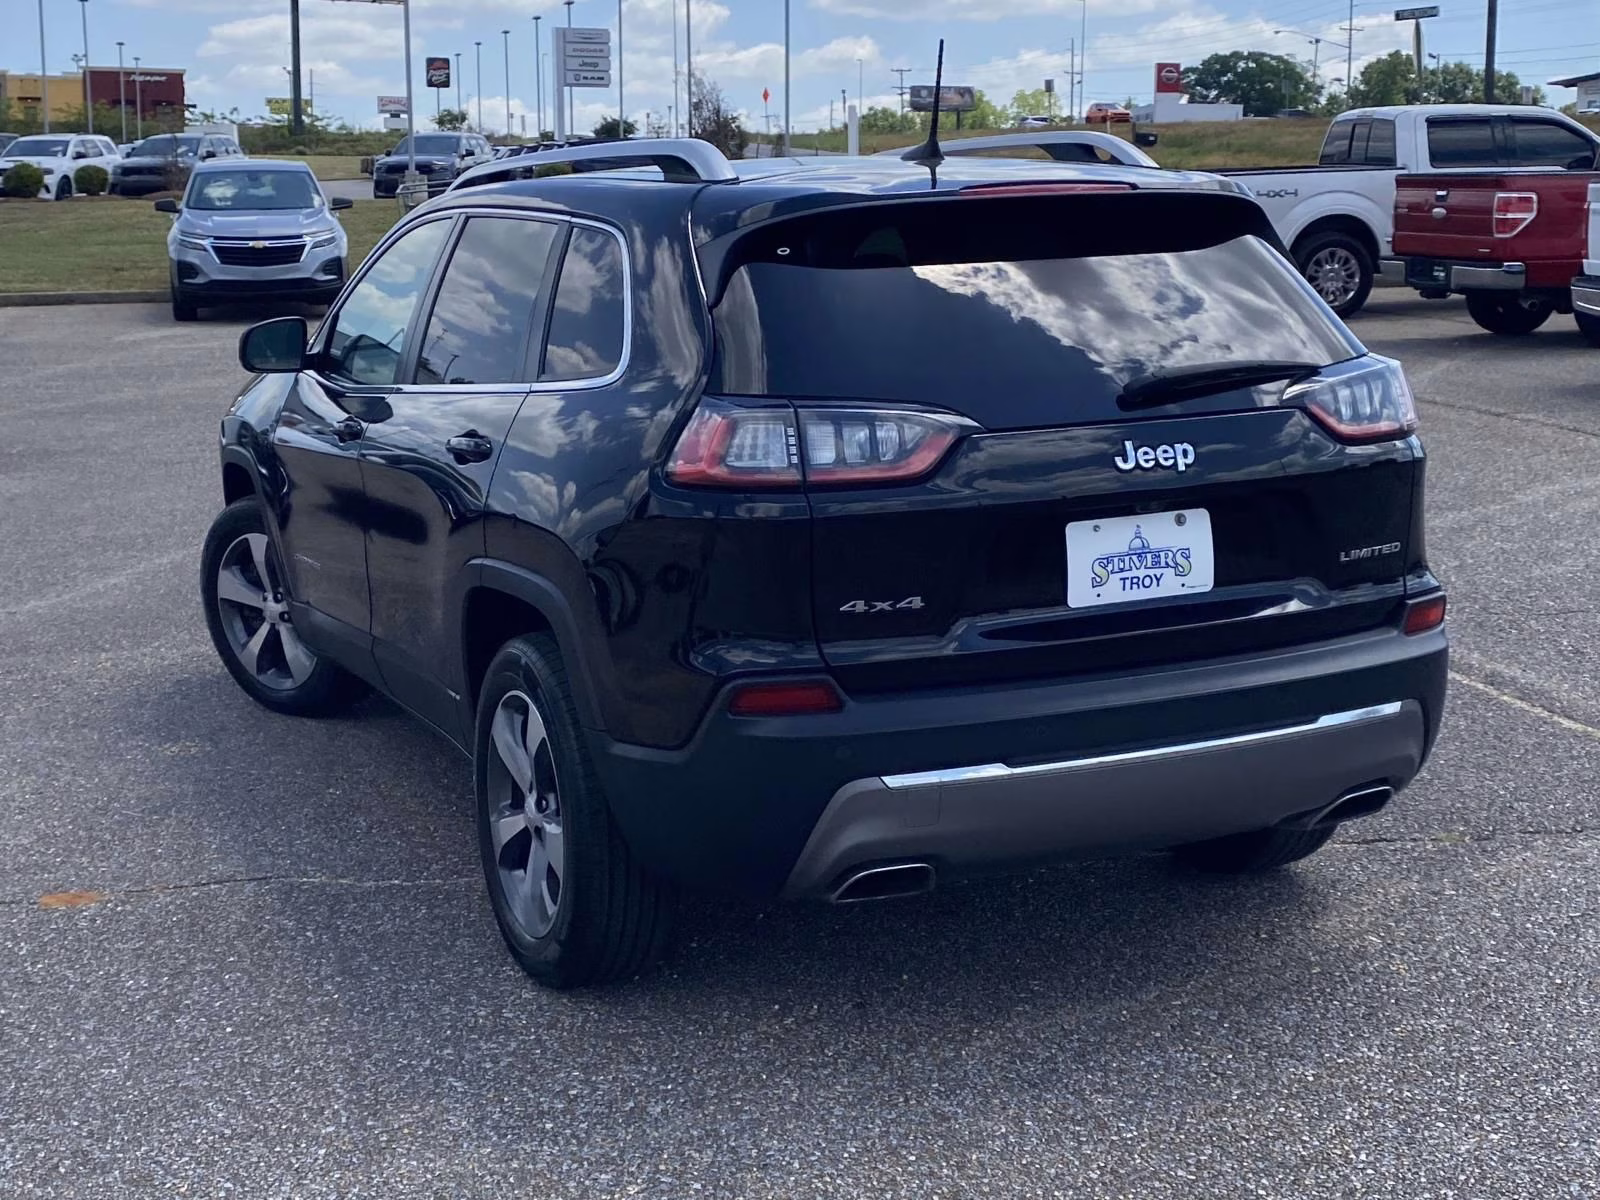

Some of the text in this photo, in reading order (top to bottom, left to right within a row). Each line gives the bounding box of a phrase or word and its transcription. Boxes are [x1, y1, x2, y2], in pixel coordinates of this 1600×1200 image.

[578, 59, 600, 69] Jeep
[1114, 439, 1196, 472] Jeep
[1339, 541, 1401, 562] LIMITED
[1091, 547, 1192, 589] STIVERS
[1119, 572, 1164, 592] TROY
